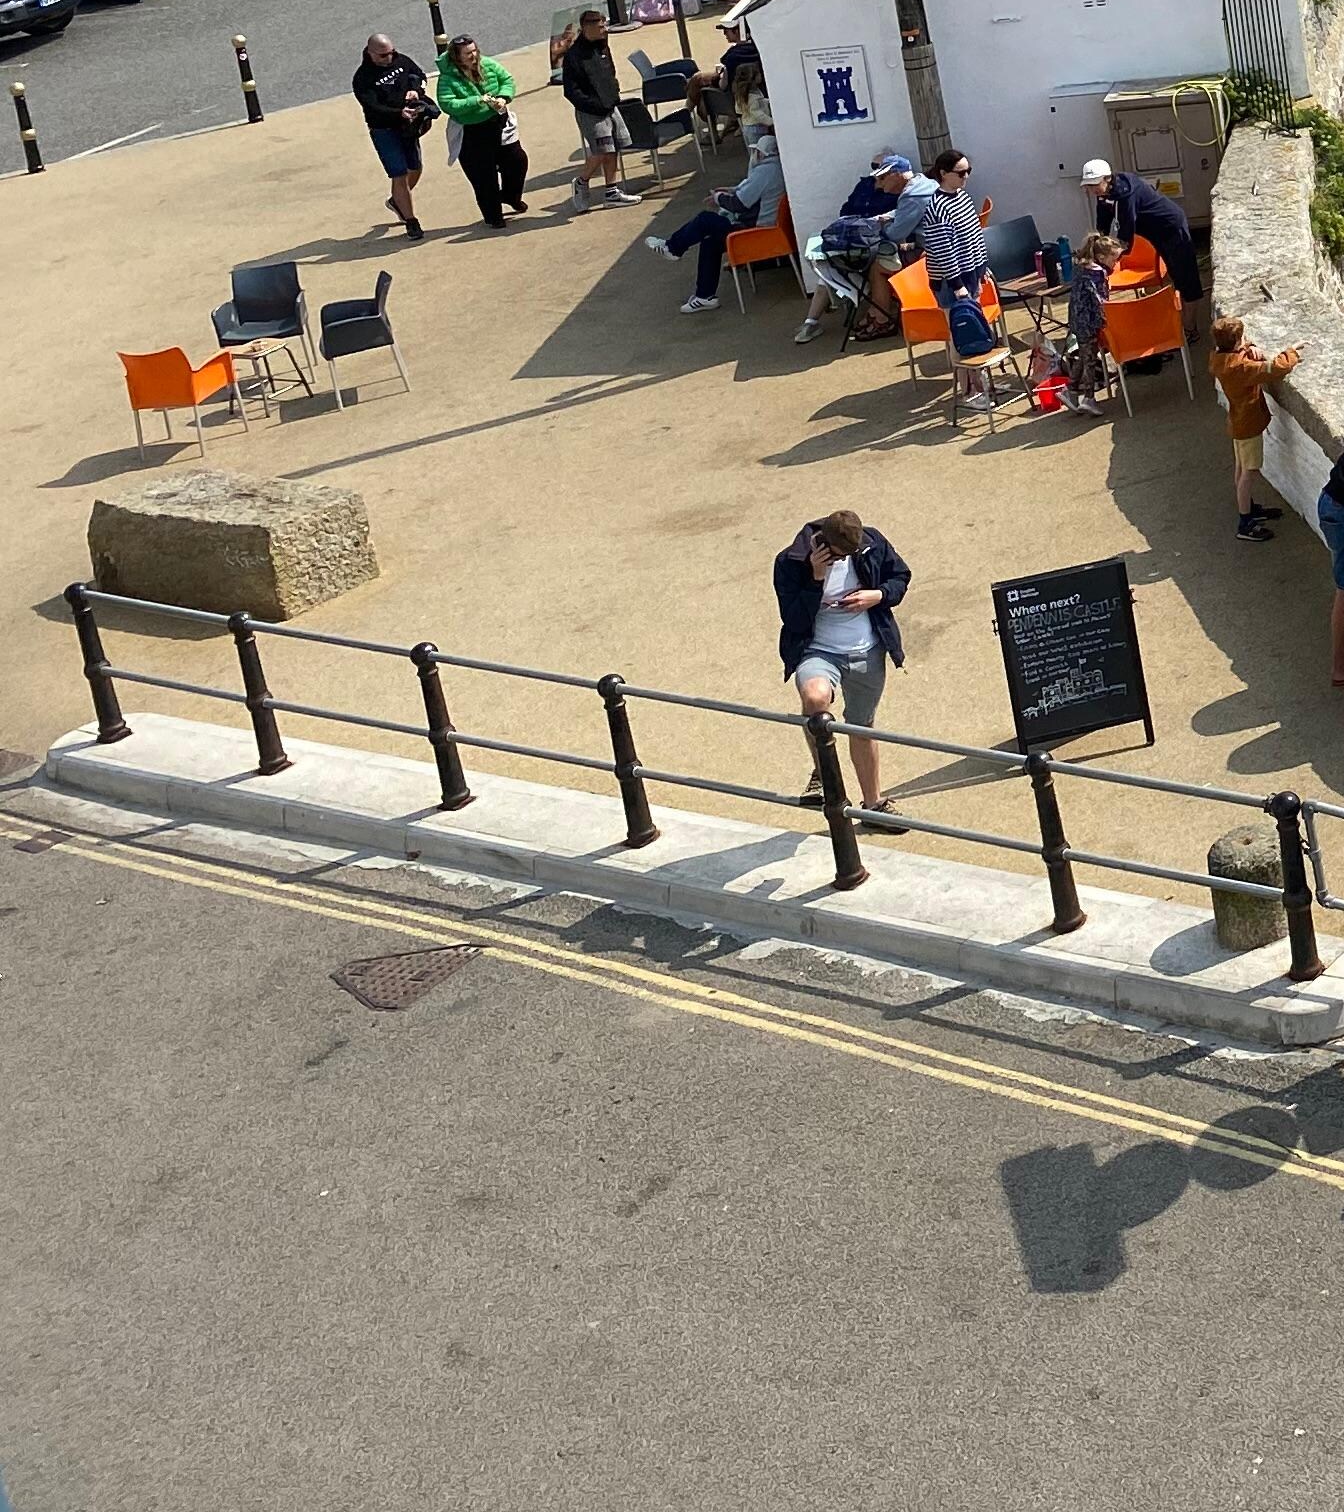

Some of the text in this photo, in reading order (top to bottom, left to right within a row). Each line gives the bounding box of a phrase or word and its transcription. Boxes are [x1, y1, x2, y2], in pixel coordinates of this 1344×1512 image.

[1009, 601, 1047, 618] Where
[1048, 593, 1082, 610] next?
[1007, 607, 1072, 634] PENDENNIS
